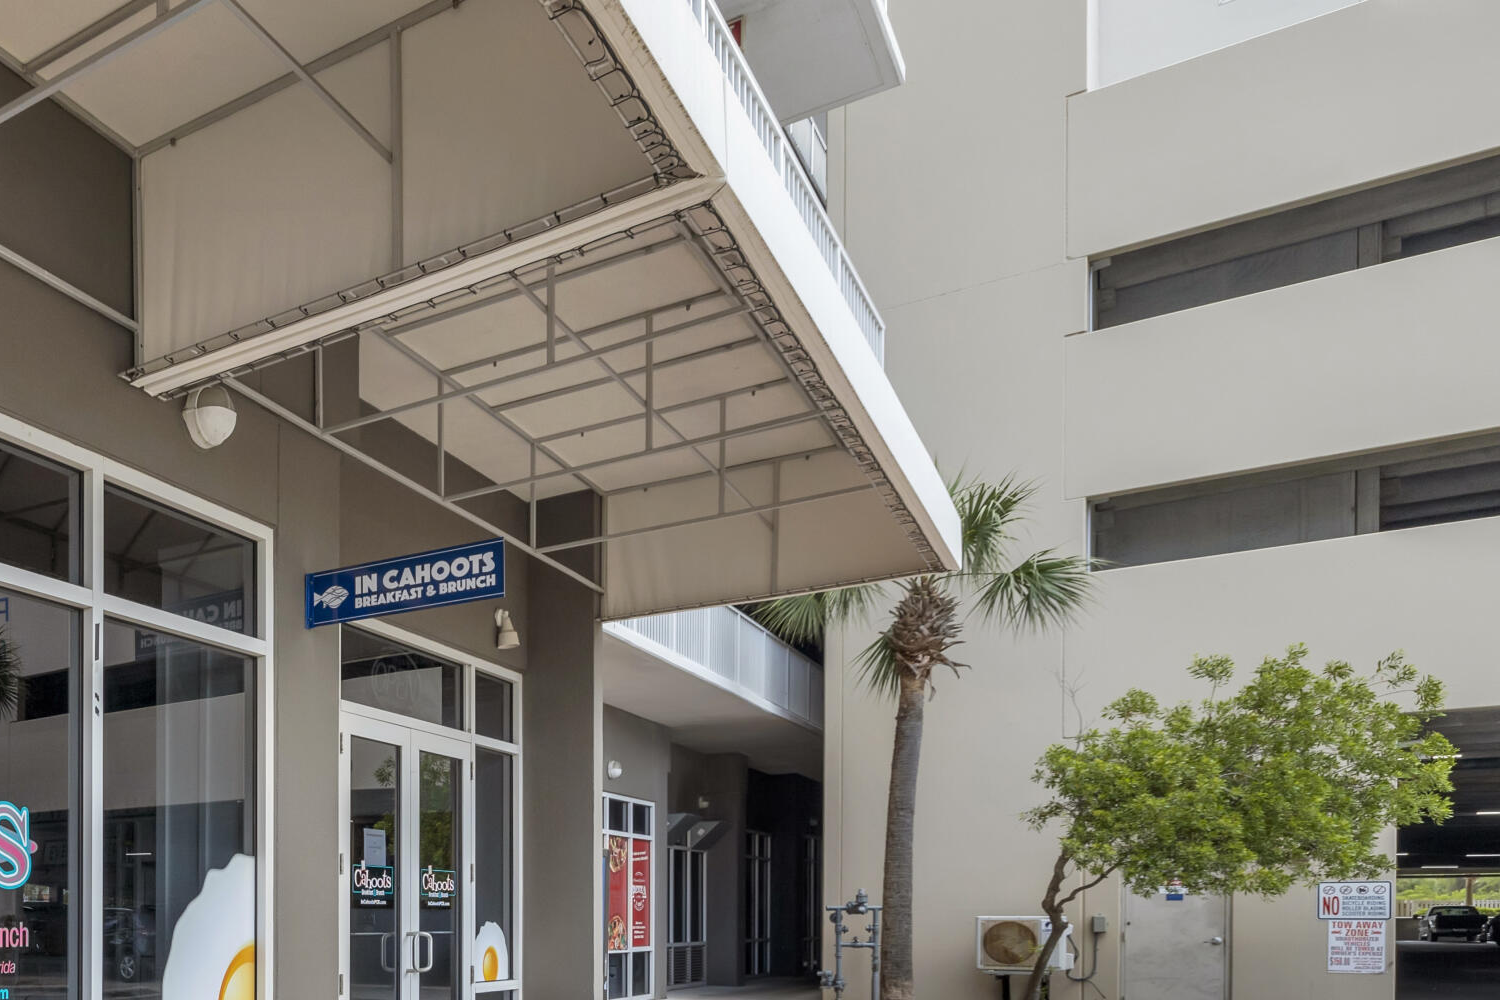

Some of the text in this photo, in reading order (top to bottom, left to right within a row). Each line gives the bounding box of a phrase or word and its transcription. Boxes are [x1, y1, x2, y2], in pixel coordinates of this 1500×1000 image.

[355, 551, 496, 595] IN CAHOOTS
[354, 573, 497, 609] BREAKFAST & BRUNCH
[354, 869, 392, 889] Cahoots
[422, 873, 455, 892] Cahoots
[1322, 895, 1340, 916] NO
[1345, 929, 1369, 937] ZONE
